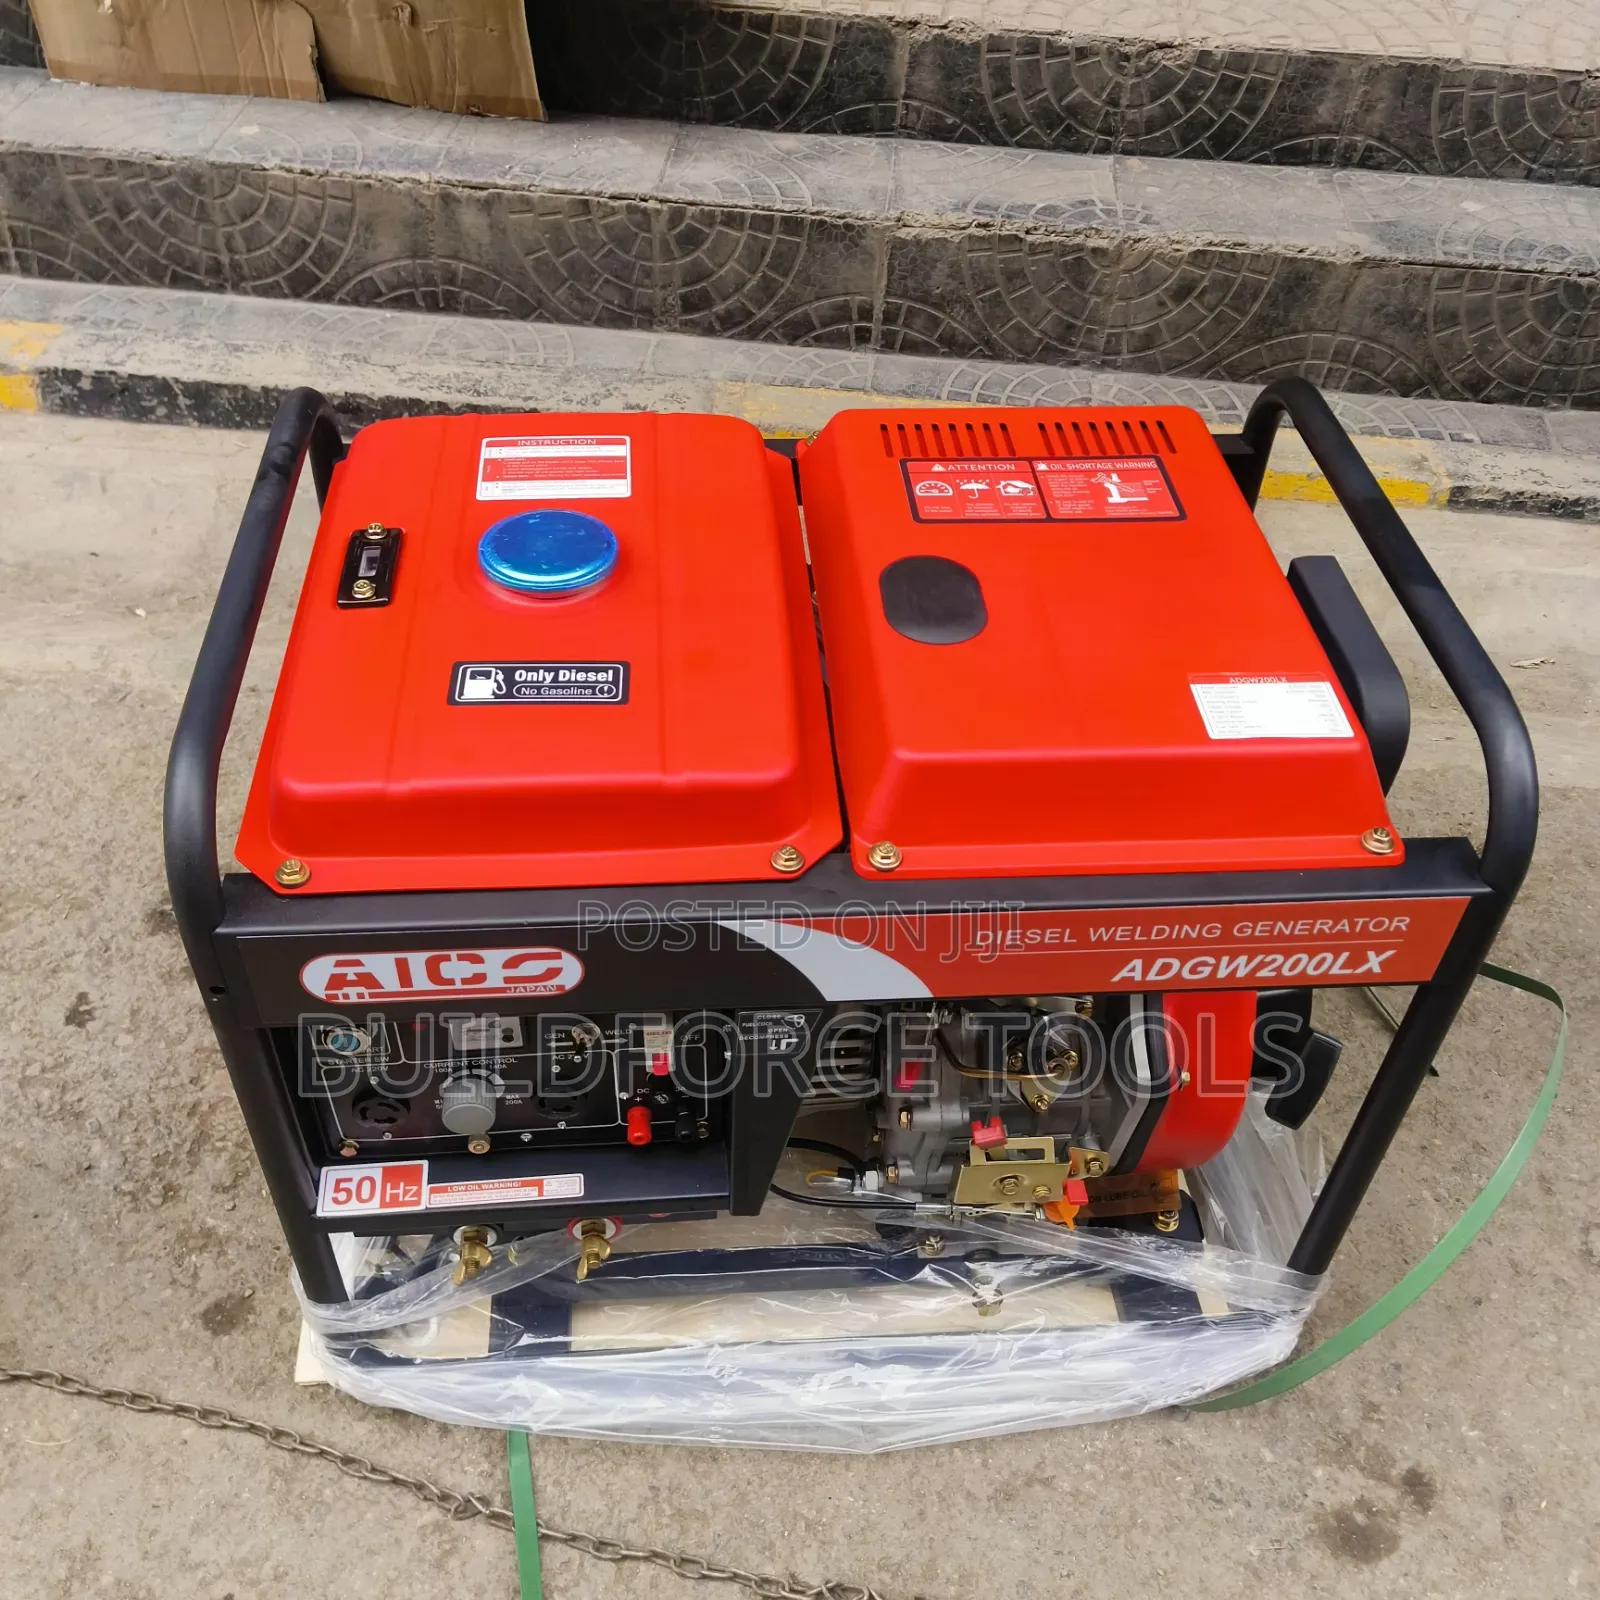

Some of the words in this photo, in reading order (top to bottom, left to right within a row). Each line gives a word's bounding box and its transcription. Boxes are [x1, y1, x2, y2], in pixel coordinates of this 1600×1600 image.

[517, 438, 597, 446] INSTRUCTION
[947, 463, 1016, 471] ATTENTION
[1067, 462, 1113, 470] SHORTAGE
[1114, 461, 1158, 469] WARNING
[514, 669, 556, 684] Only
[558, 669, 613, 682] Diesel
[1229, 676, 1288, 684] ADGW200LX
[520, 687, 538, 695] No
[540, 687, 593, 695] Gasoline
[975, 928, 1078, 946] DIESEL
[1088, 923, 1222, 942] WELDING
[1232, 916, 1411, 938] GENERATOR
[1111, 949, 1398, 982] ADGW200LX
[505, 984, 558, 994] JAPAN
[423, 1060, 469, 1069] CURRENT
[472, 1057, 519, 1066] CONTROL
[481, 1181, 522, 1190] WARNING!
[331, 1176, 376, 1206] 50
[385, 1181, 418, 1203] Hz
